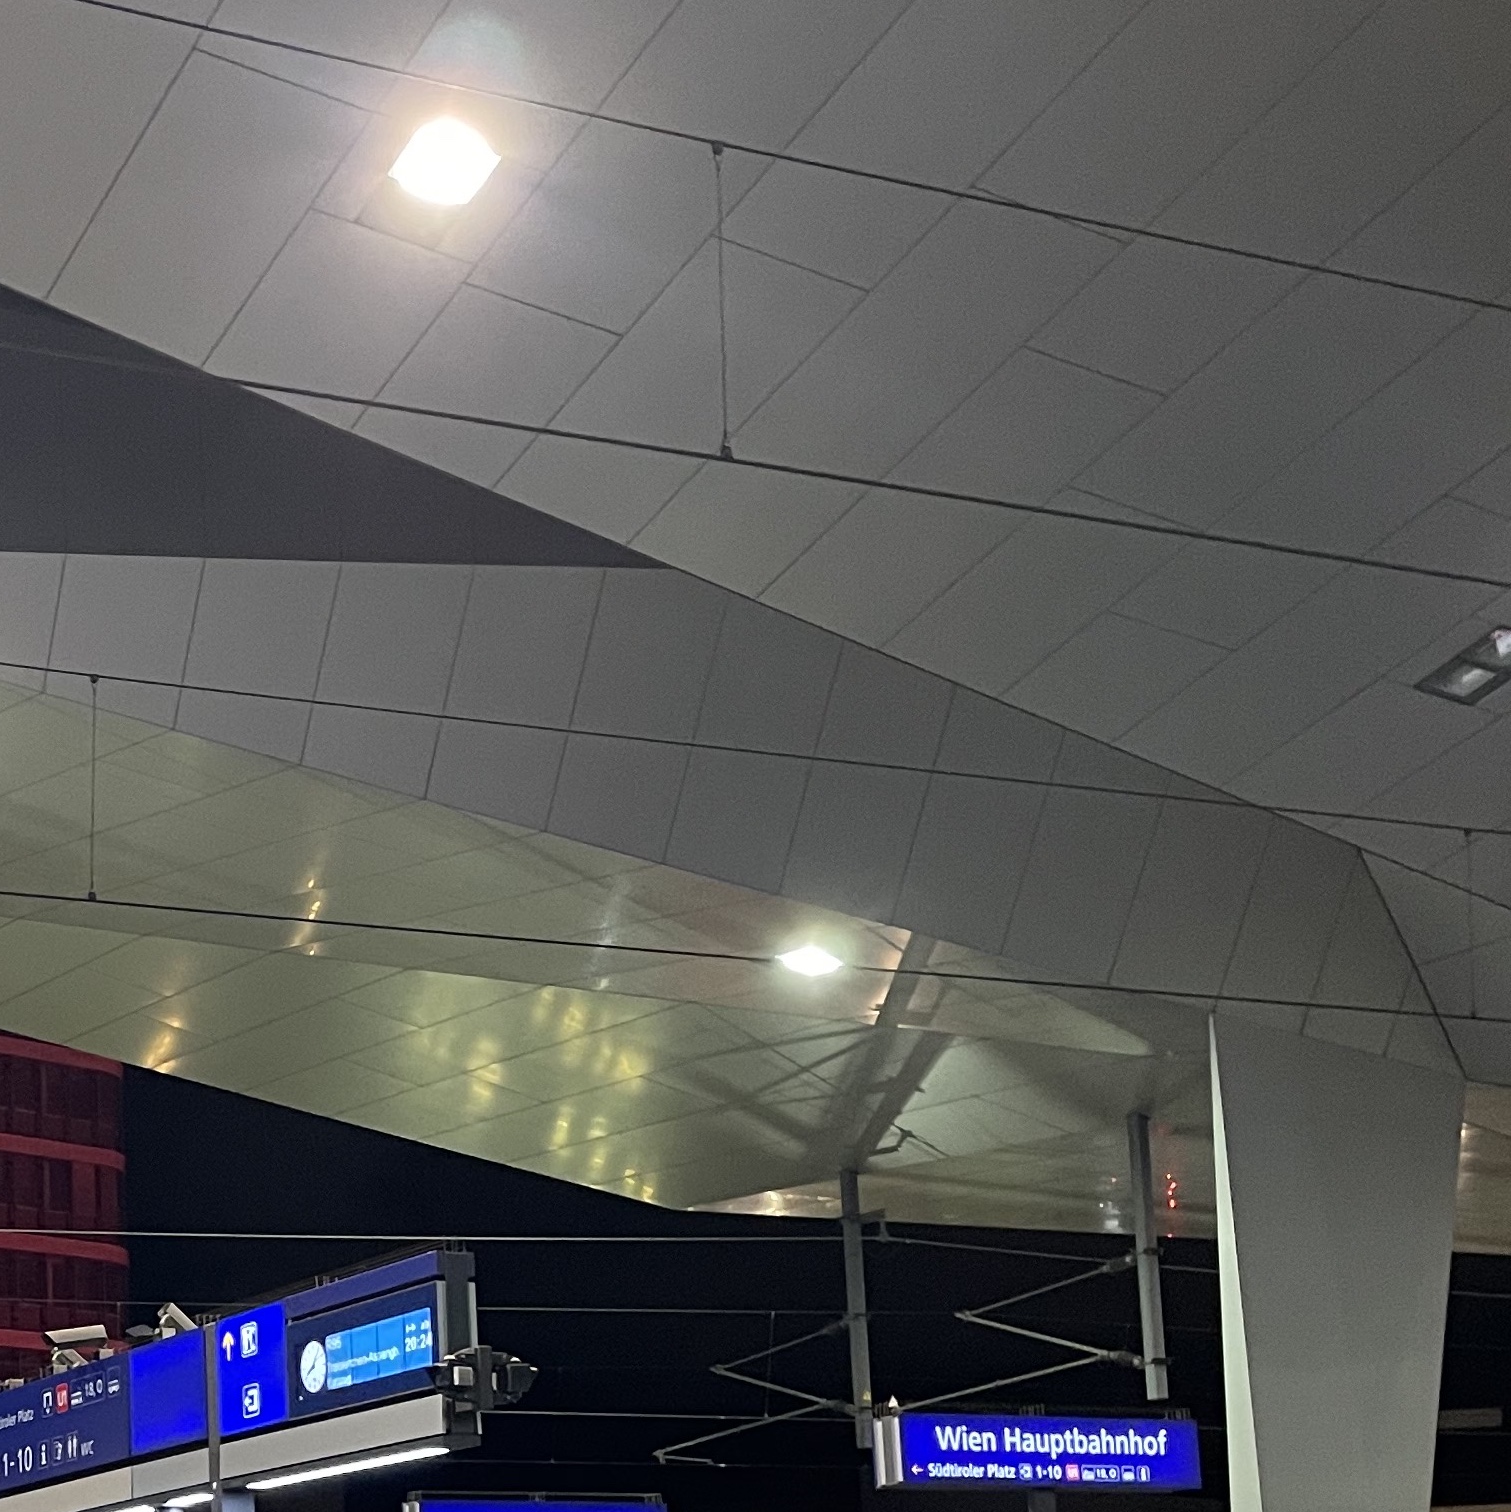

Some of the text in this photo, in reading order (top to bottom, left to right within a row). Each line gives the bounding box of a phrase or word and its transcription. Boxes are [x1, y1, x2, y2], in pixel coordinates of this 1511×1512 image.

[17, 1408, 35, 1423] Platz
[935, 1425, 1168, 1460] Wien Hauptbahnhof
[2, 1439, 95, 1477] 1-10 WC
[927, 1462, 985, 1479] Südtiroler
[987, 1463, 1017, 1479] Platz
[1035, 1464, 1063, 1480] 1-10
